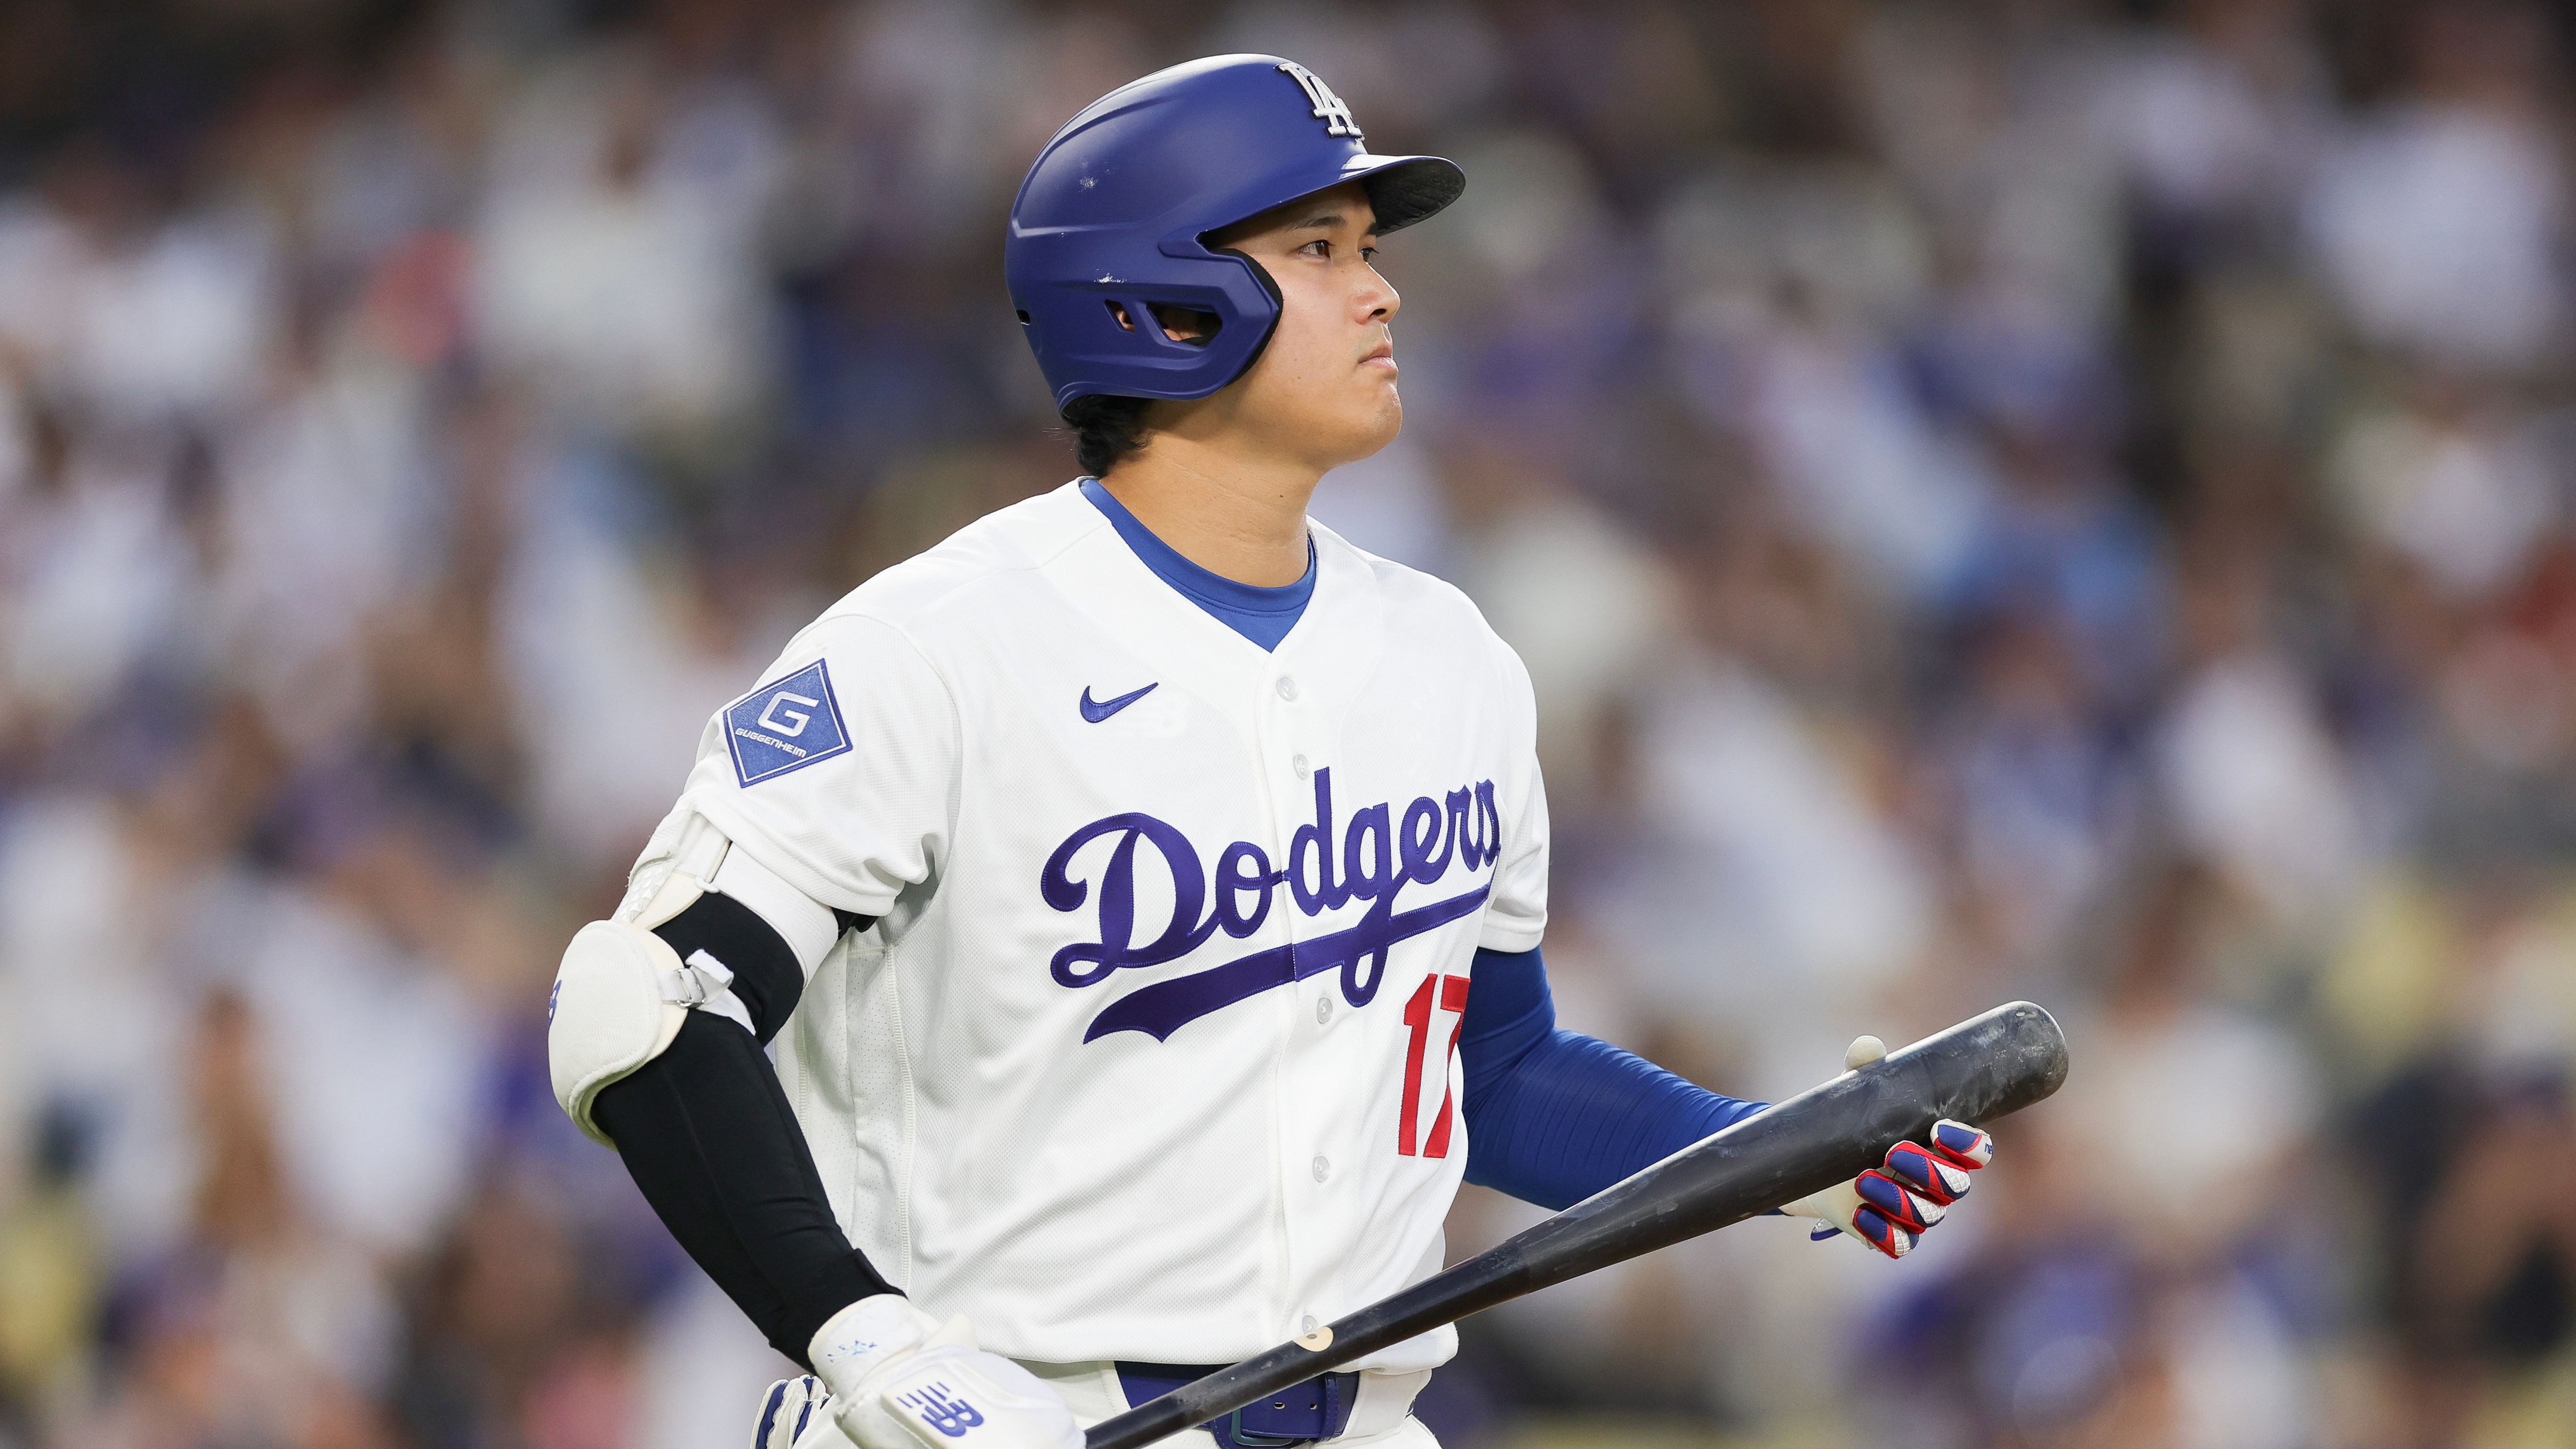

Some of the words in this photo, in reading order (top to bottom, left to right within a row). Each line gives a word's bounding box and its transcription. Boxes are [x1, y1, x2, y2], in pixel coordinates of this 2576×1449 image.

[1275, 62, 1363, 136] LA
[735, 727, 807, 758] GUGGENHEIM
[757, 691, 819, 737] G
[1040, 766, 1501, 1008] Dodgers
[1398, 973, 1470, 1159] 17
